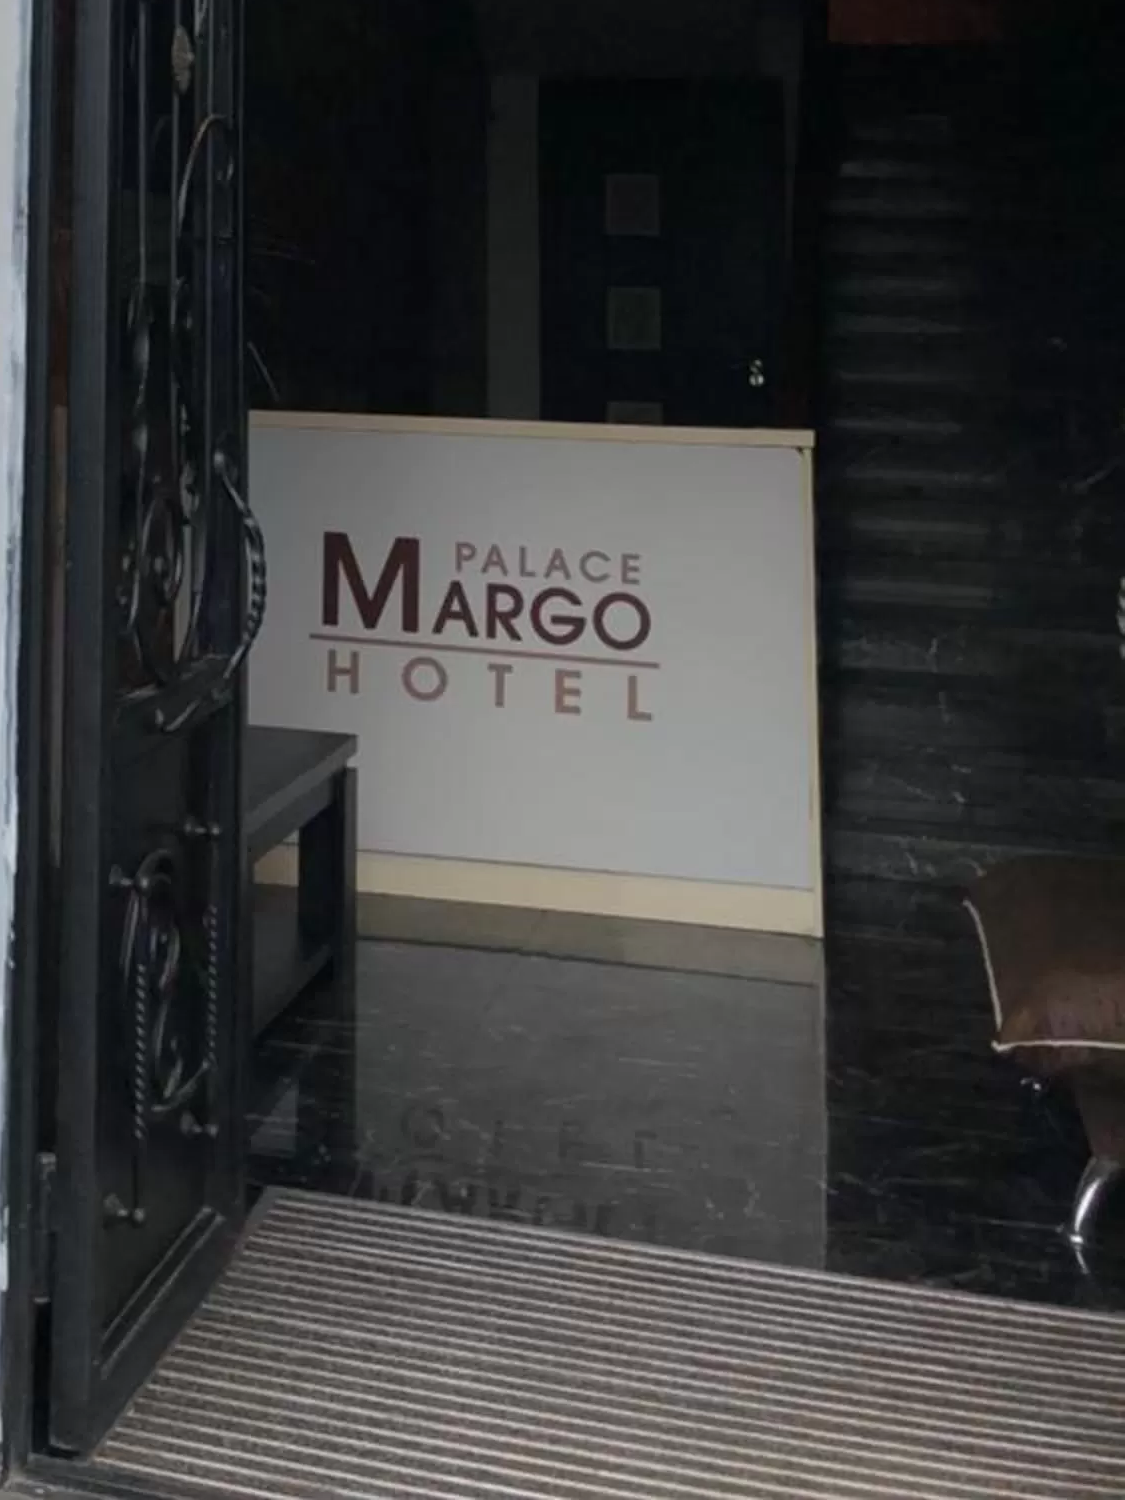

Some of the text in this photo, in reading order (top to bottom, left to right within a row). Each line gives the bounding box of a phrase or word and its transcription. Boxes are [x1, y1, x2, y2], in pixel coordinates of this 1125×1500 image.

[321, 531, 652, 651] MARGO
[454, 541, 642, 586] PALACE
[327, 648, 654, 722] HOTEL
